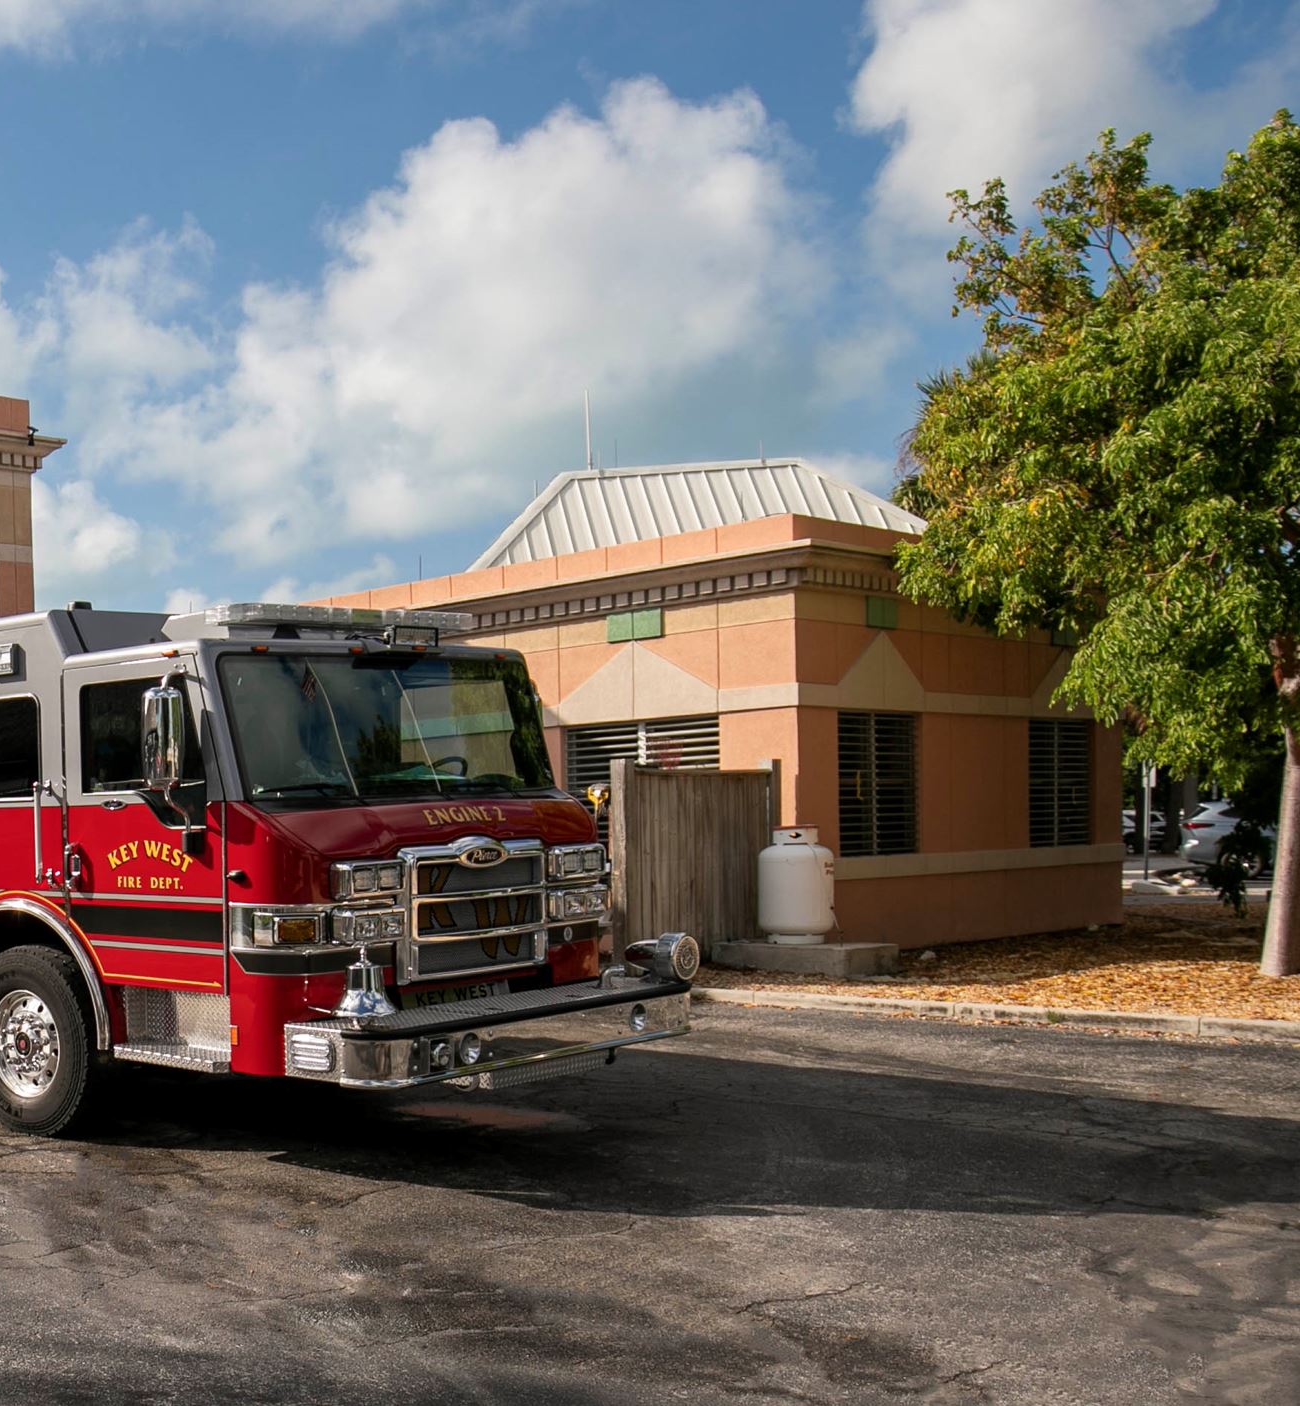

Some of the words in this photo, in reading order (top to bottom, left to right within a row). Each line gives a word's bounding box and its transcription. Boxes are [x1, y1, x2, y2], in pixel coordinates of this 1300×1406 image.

[423, 806, 492, 826] ENGINE
[494, 807, 506, 821] 2
[107, 840, 139, 869] KEY
[143, 840, 193, 872] WEST
[471, 849, 498, 864] Pierce
[117, 876, 142, 888] FIRE
[150, 876, 183, 890] DEPT.
[416, 990, 446, 1007] KEY
[453, 983, 495, 1001] WEST
